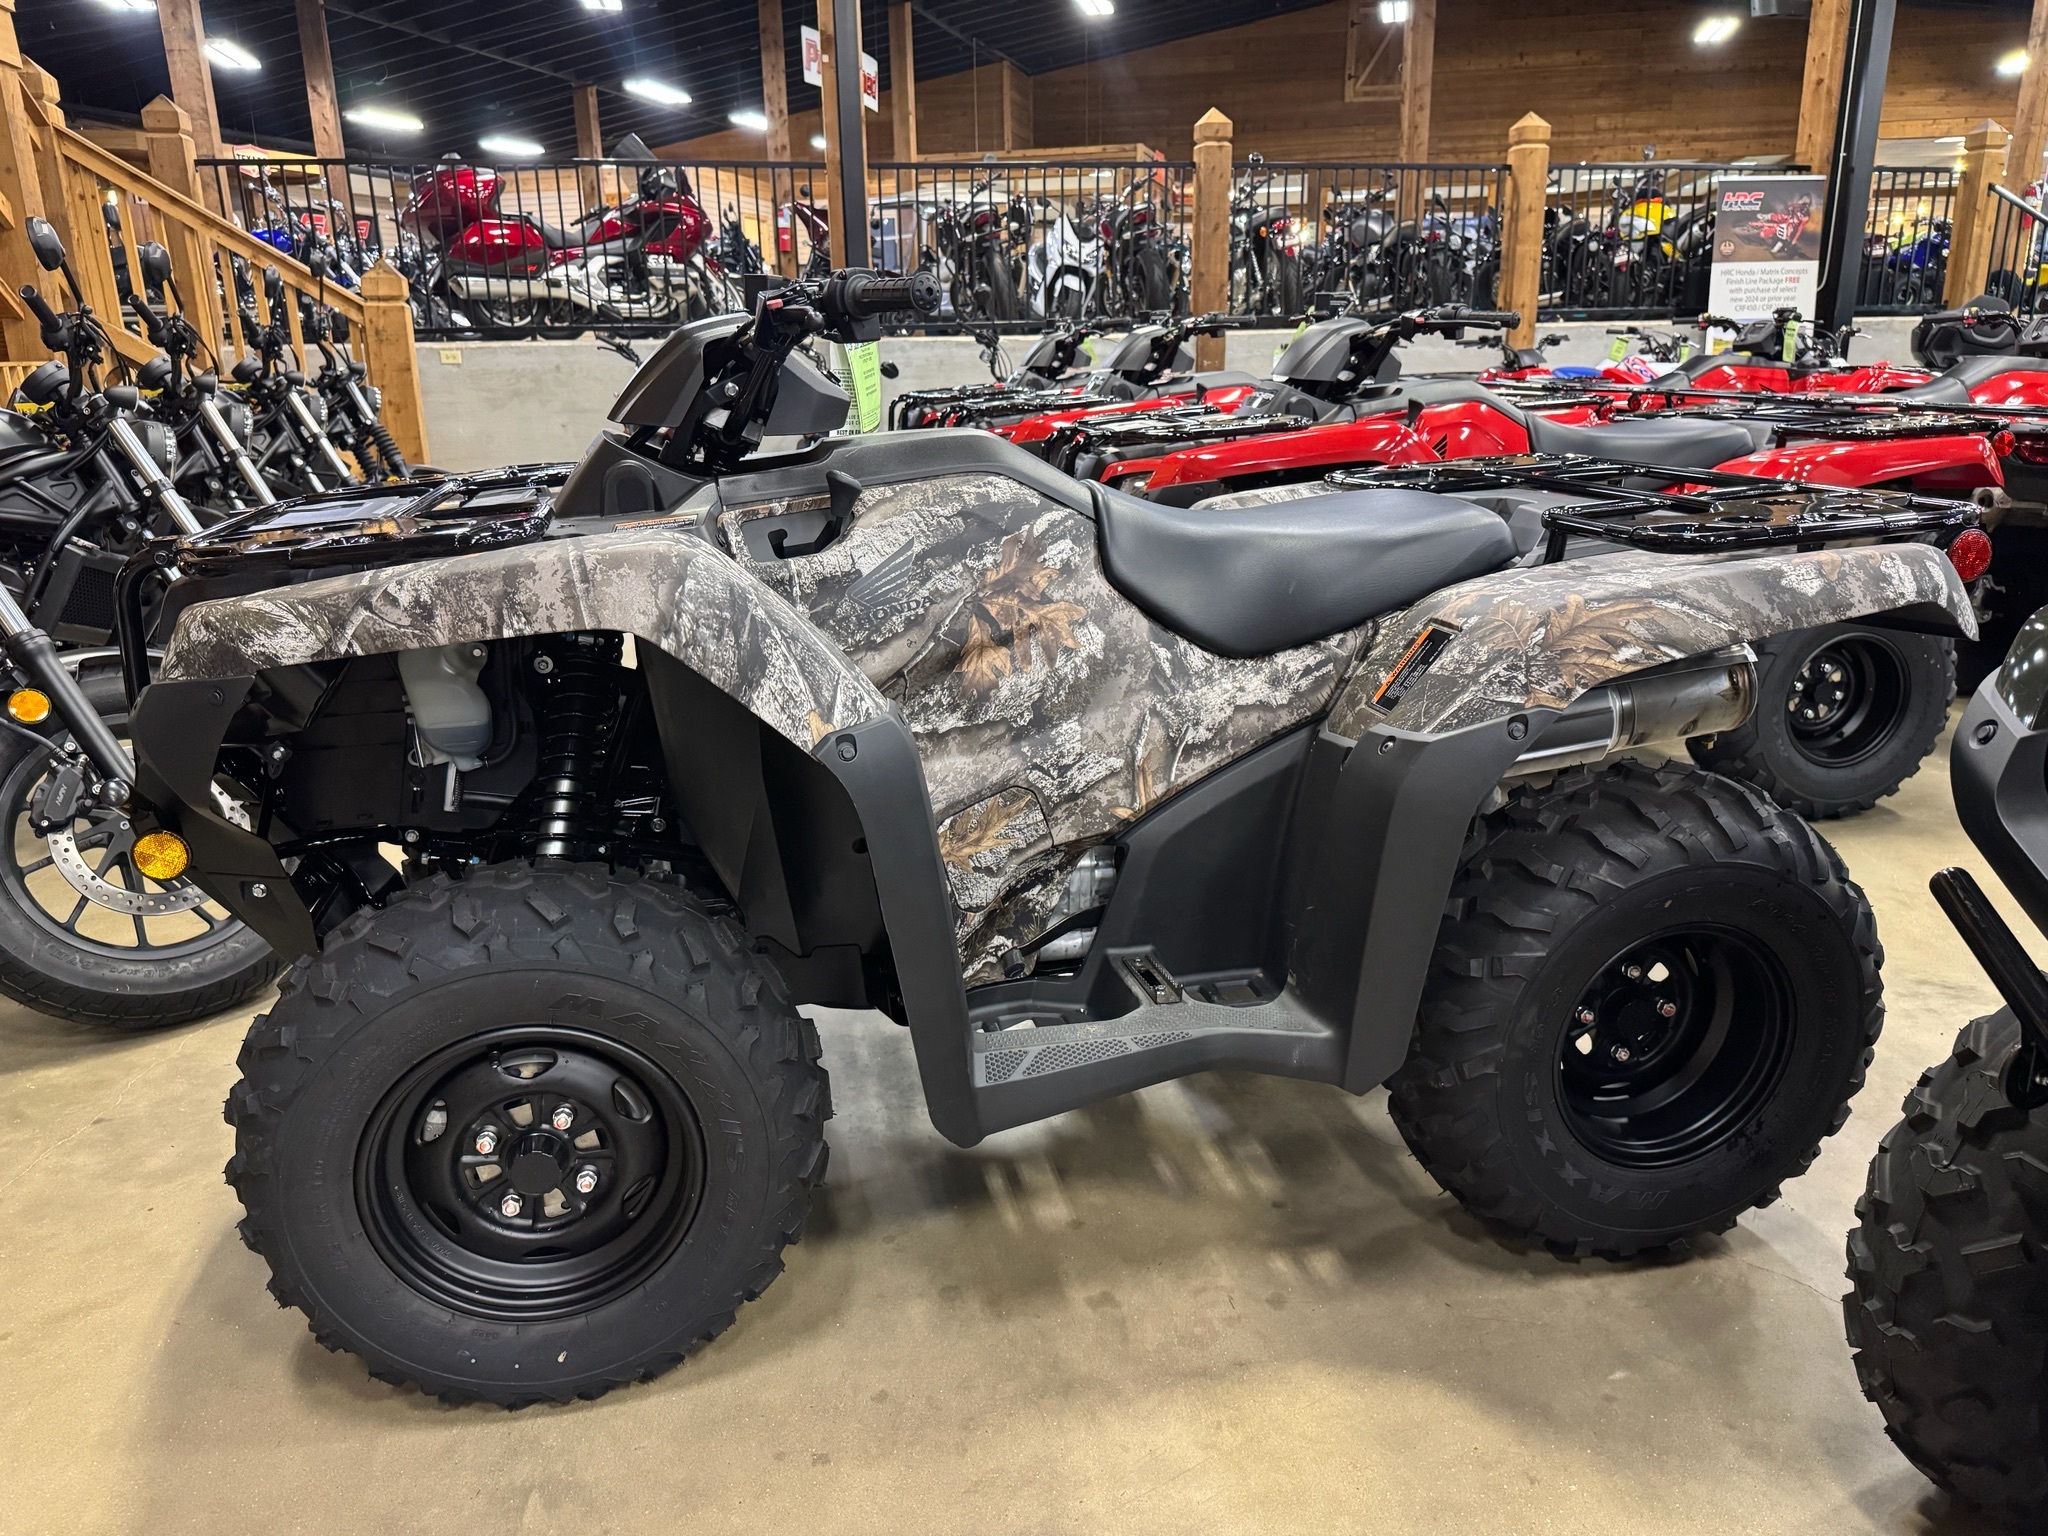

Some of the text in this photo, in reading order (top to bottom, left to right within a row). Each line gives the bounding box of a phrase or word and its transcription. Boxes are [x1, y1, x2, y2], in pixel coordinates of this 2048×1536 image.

[1722, 192, 1765, 208] HRC
[1781, 268, 1808, 276] Concepts
[1759, 277, 1784, 286] Package
[1780, 285, 1797, 293] select
[1767, 295, 1782, 303] prior
[857, 596, 938, 628] HONDA
[1391, 642, 1420, 677] WARNING
[548, 991, 749, 1176] MAXXIS
[1524, 1071, 1672, 1211] MAXXIS
